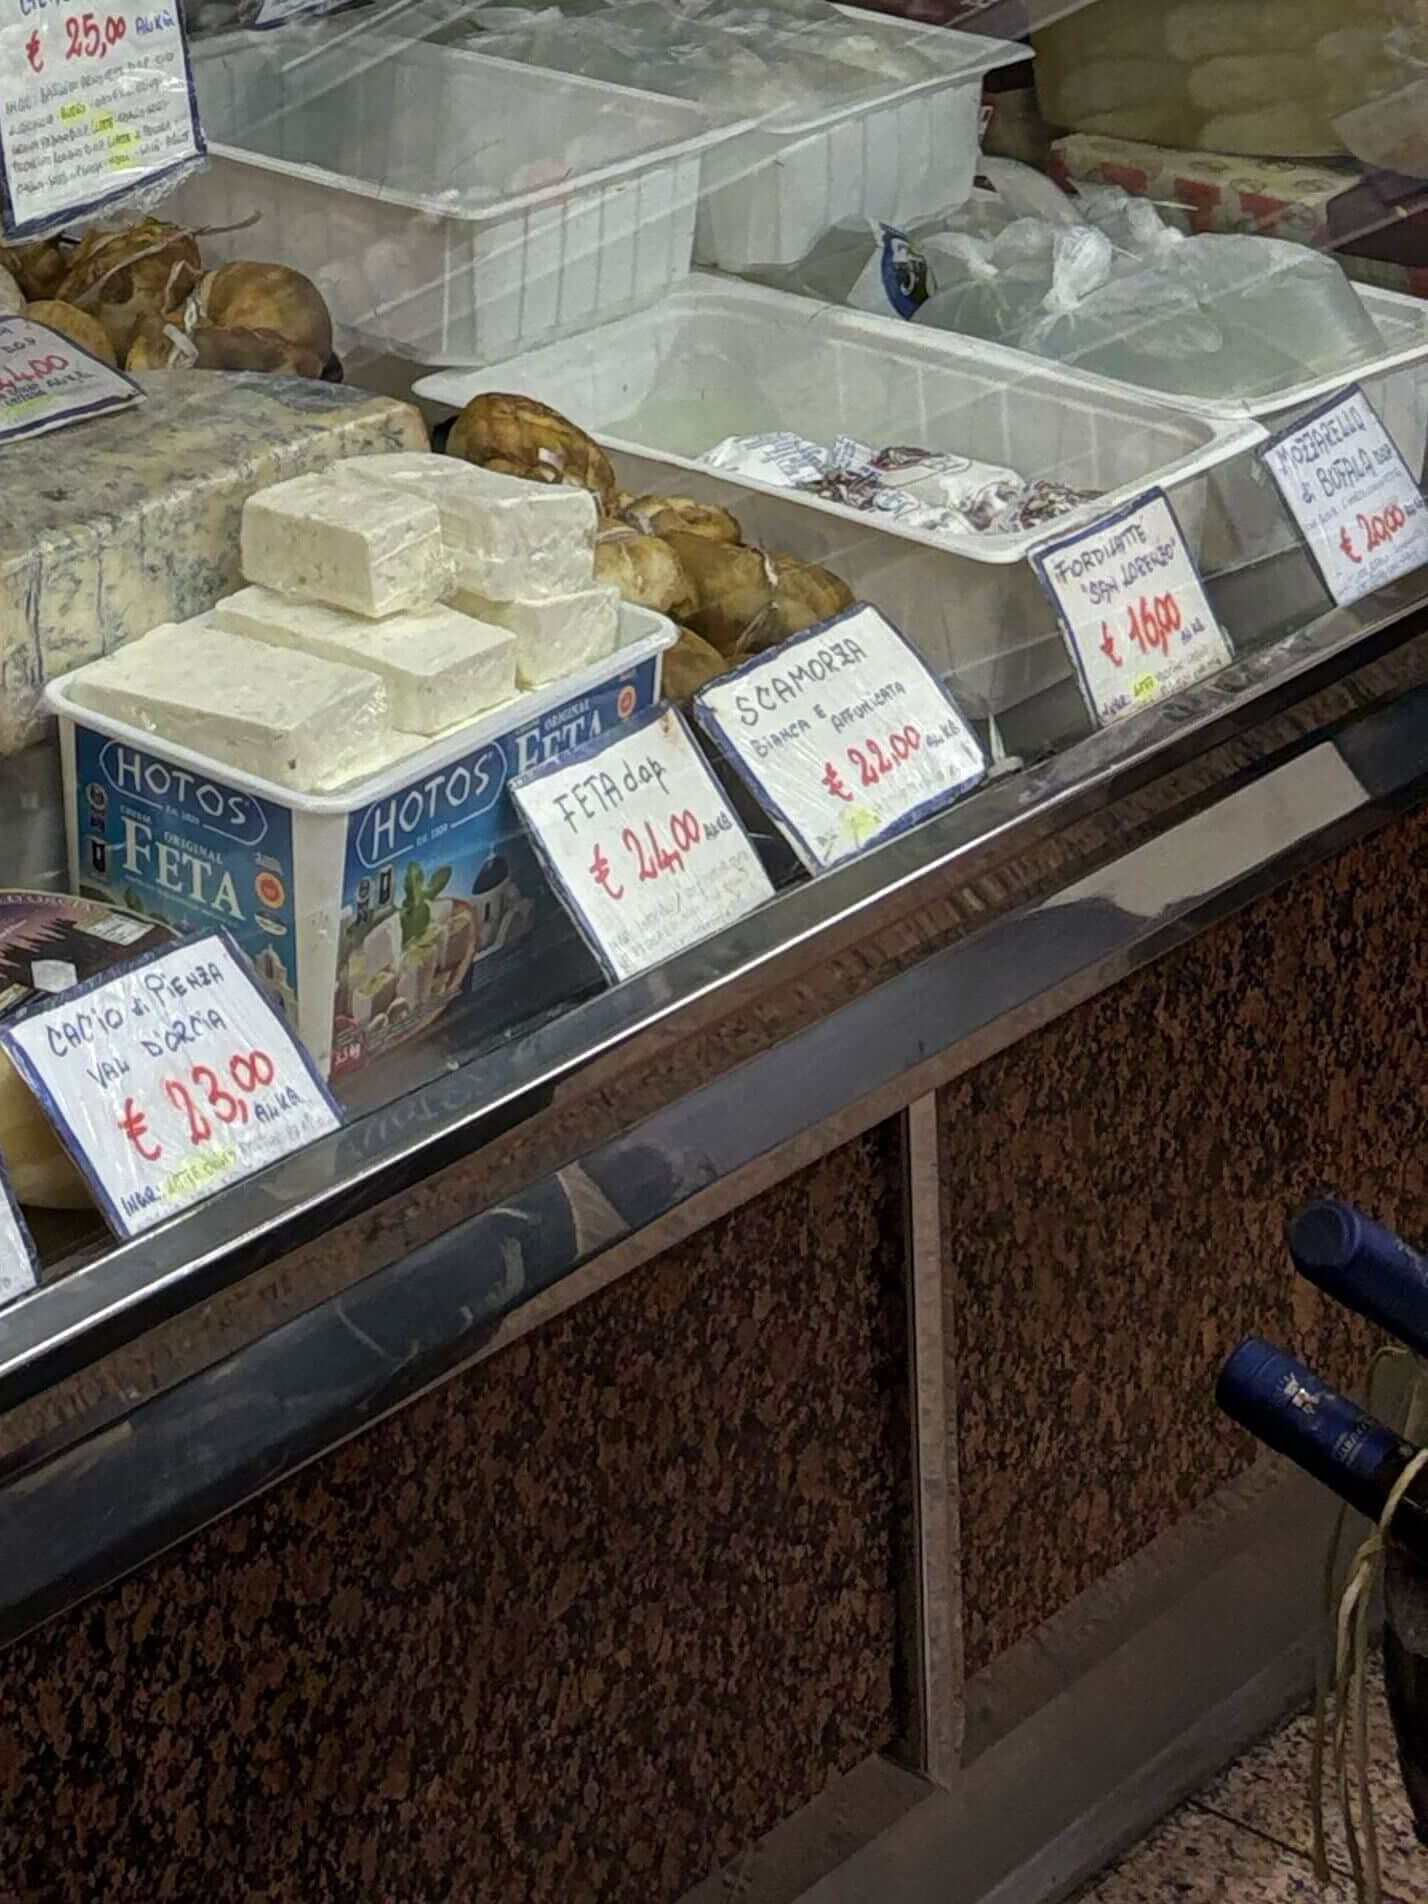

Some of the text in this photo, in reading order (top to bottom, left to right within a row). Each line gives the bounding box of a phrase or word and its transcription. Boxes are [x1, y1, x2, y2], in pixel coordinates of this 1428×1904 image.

[25, 11, 127, 72] € 25,00
[1356, 504, 1407, 552] 20,00
[1128, 591, 1181, 657] 16,00
[735, 638, 868, 727] SCAMORZA
[749, 704, 826, 758] BIANCA E
[821, 723, 922, 802] € 22,00
[118, 748, 247, 825] HOTOS
[371, 753, 492, 861] HOTOS
[552, 772, 625, 835] FETA
[121, 815, 246, 920] FETA
[164, 831, 223, 865] ORIGINAL
[589, 809, 701, 900] € 24,00
[46, 962, 225, 1059] CACIO PIENZA
[86, 1008, 228, 1091] VAL D'ORCIA
[117, 1049, 275, 1161] € 23,00
